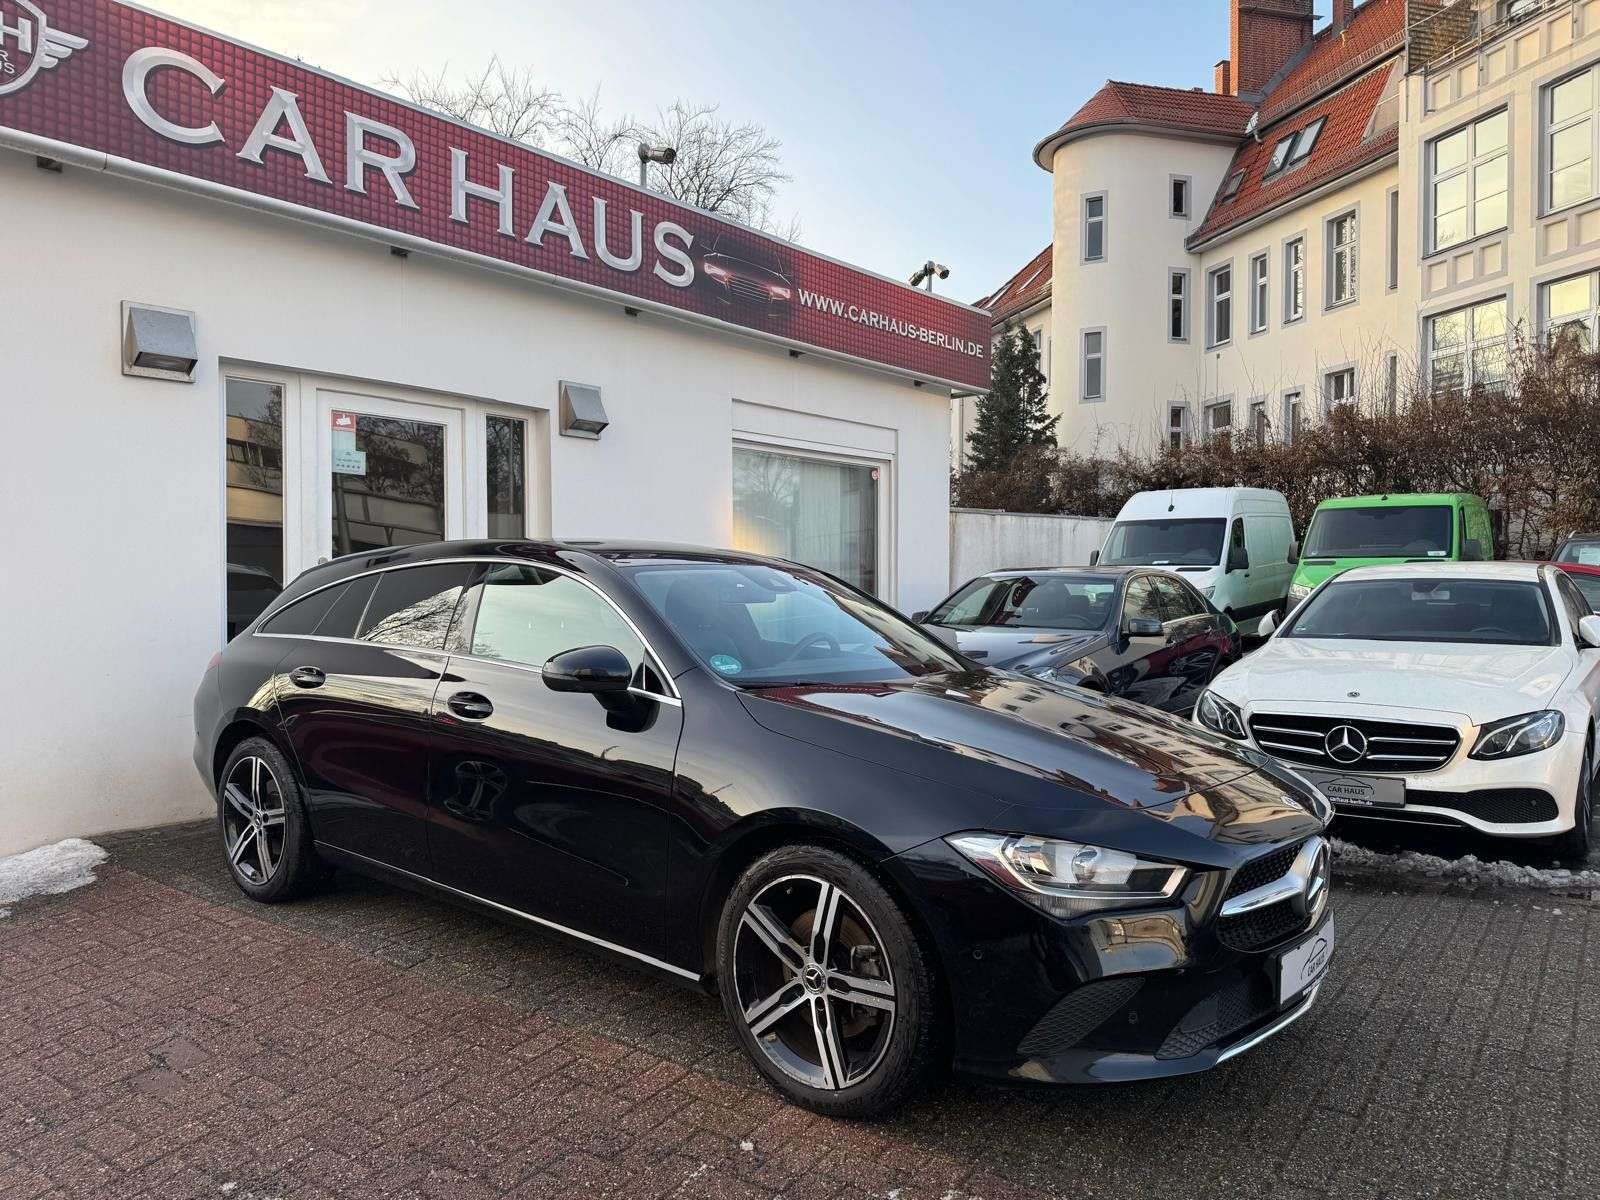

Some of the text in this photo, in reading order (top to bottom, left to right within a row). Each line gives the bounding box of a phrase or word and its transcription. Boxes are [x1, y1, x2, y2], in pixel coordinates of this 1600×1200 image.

[122, 46, 695, 288] CAR HAUS
[798, 288, 984, 358] WWW.CARHAUS-BERLIN.DE
[1328, 785, 1365, 796] CAR HAUS
